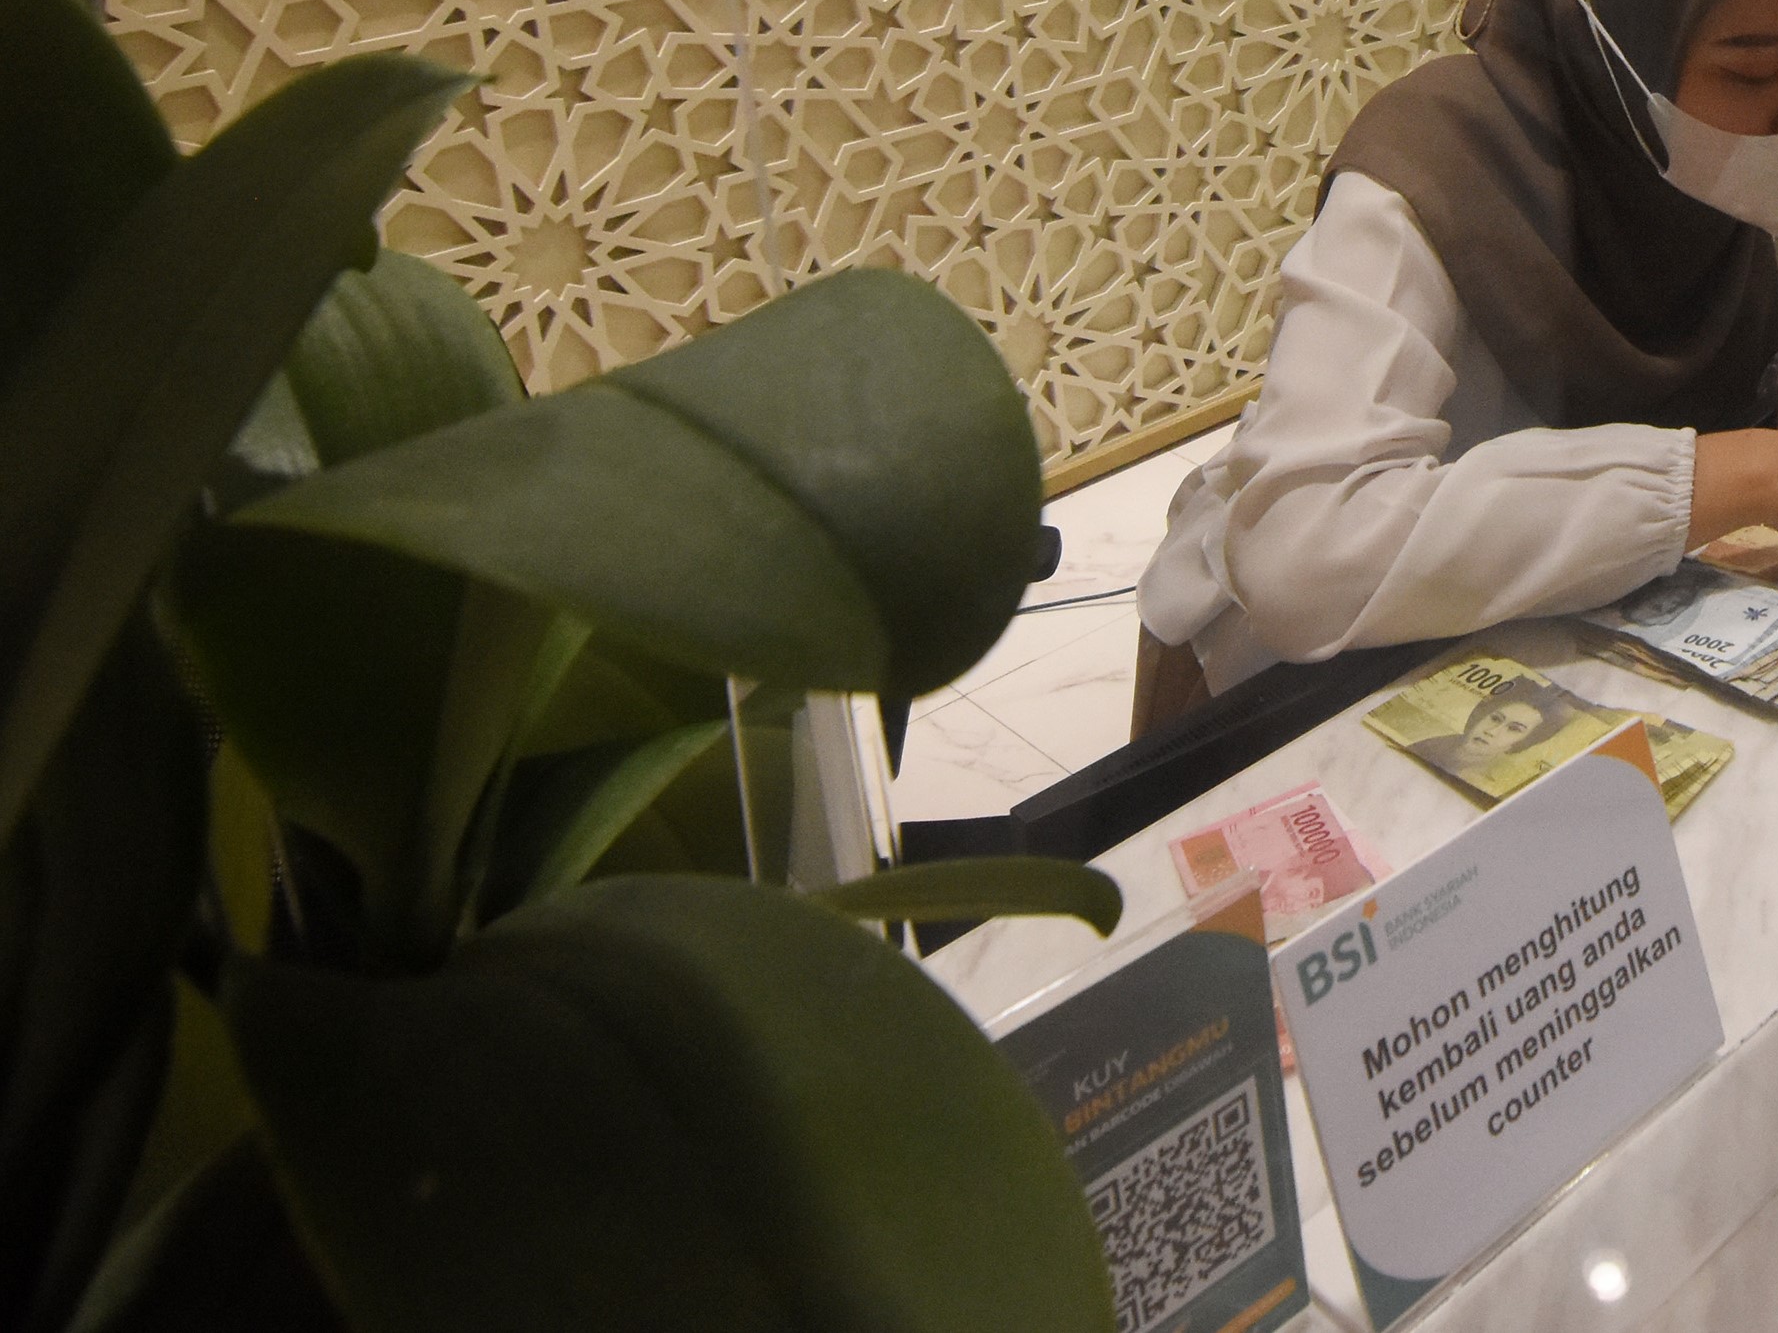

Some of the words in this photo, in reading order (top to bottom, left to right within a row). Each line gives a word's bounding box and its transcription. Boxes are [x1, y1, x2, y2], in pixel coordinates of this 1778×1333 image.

[1456, 662, 1515, 697] 1000
[1683, 633, 1735, 653] 2000
[1292, 803, 1341, 866] 100000
[1296, 920, 1379, 1007] BSI
[1361, 986, 1471, 1080] Mohon
[1476, 865, 1641, 998] menghitung
[1377, 1009, 1499, 1119] kembali
[1505, 958, 1577, 1025] uang
[1582, 906, 1647, 968] anda
[1072, 1048, 1130, 1102] KUY
[1356, 1073, 1489, 1189] sebelum
[1494, 924, 1682, 1082] meninggalkan
[1487, 1037, 1594, 1137] counter
